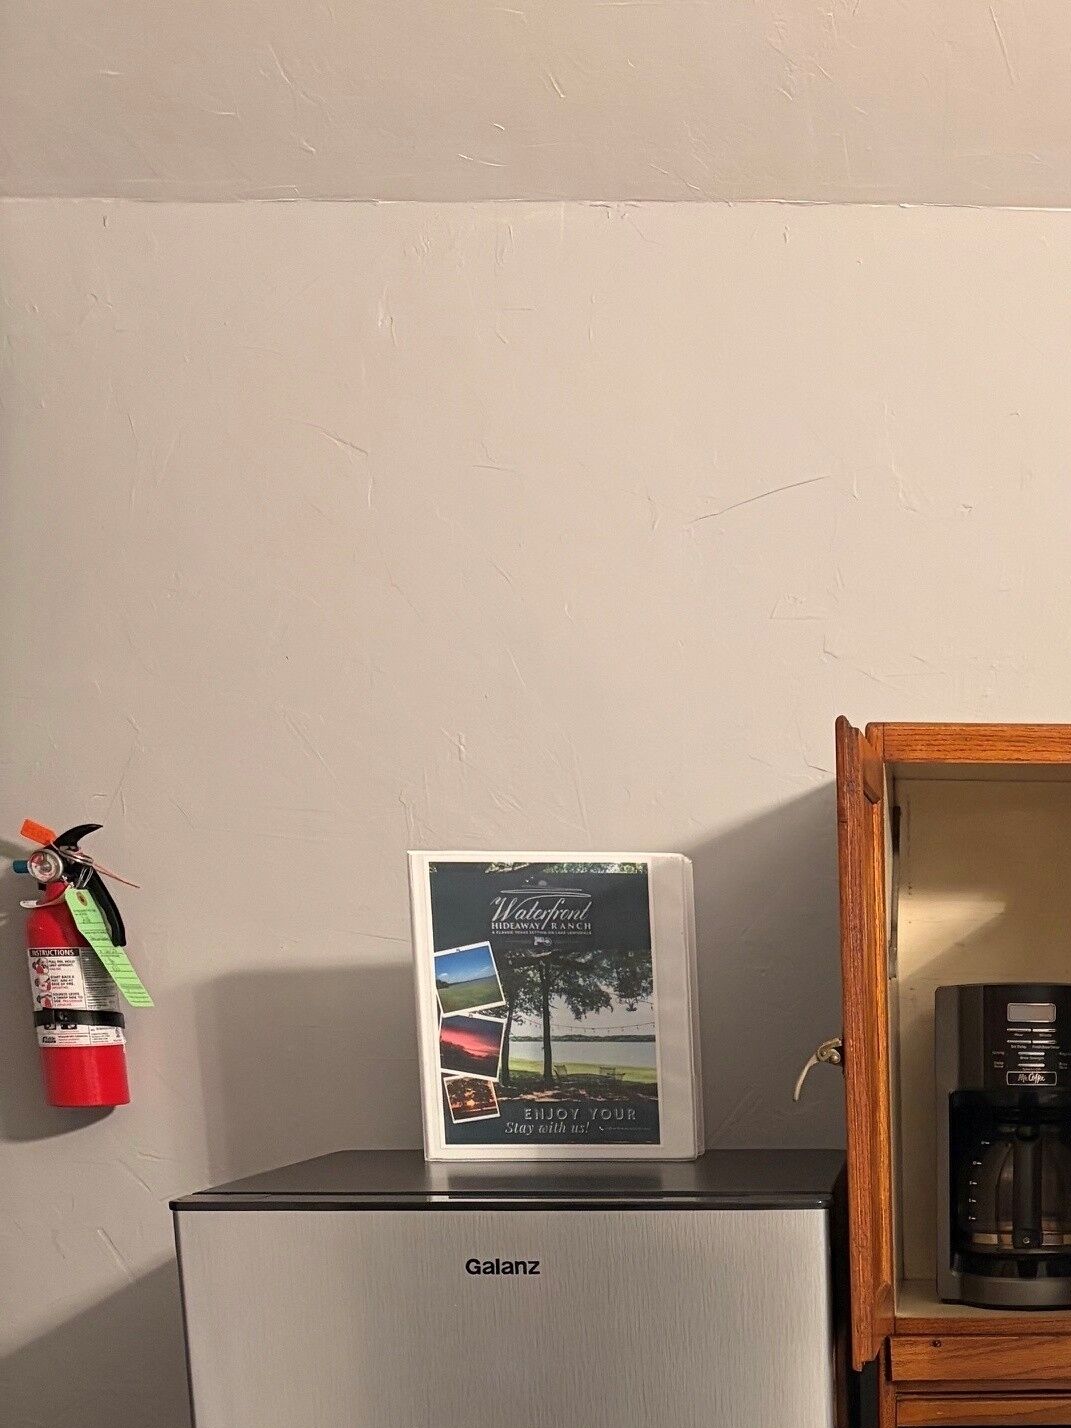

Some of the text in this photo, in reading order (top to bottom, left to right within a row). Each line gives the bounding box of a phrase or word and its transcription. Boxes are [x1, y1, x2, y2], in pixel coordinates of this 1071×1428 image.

[490, 894, 592, 930] Waterfront
[491, 922, 592, 930] HIDEAWAY RANCH
[524, 1108, 636, 1120] ENJOY YOUR
[504, 1121, 590, 1136] Stay with us!
[465, 1258, 541, 1275] Galanz
